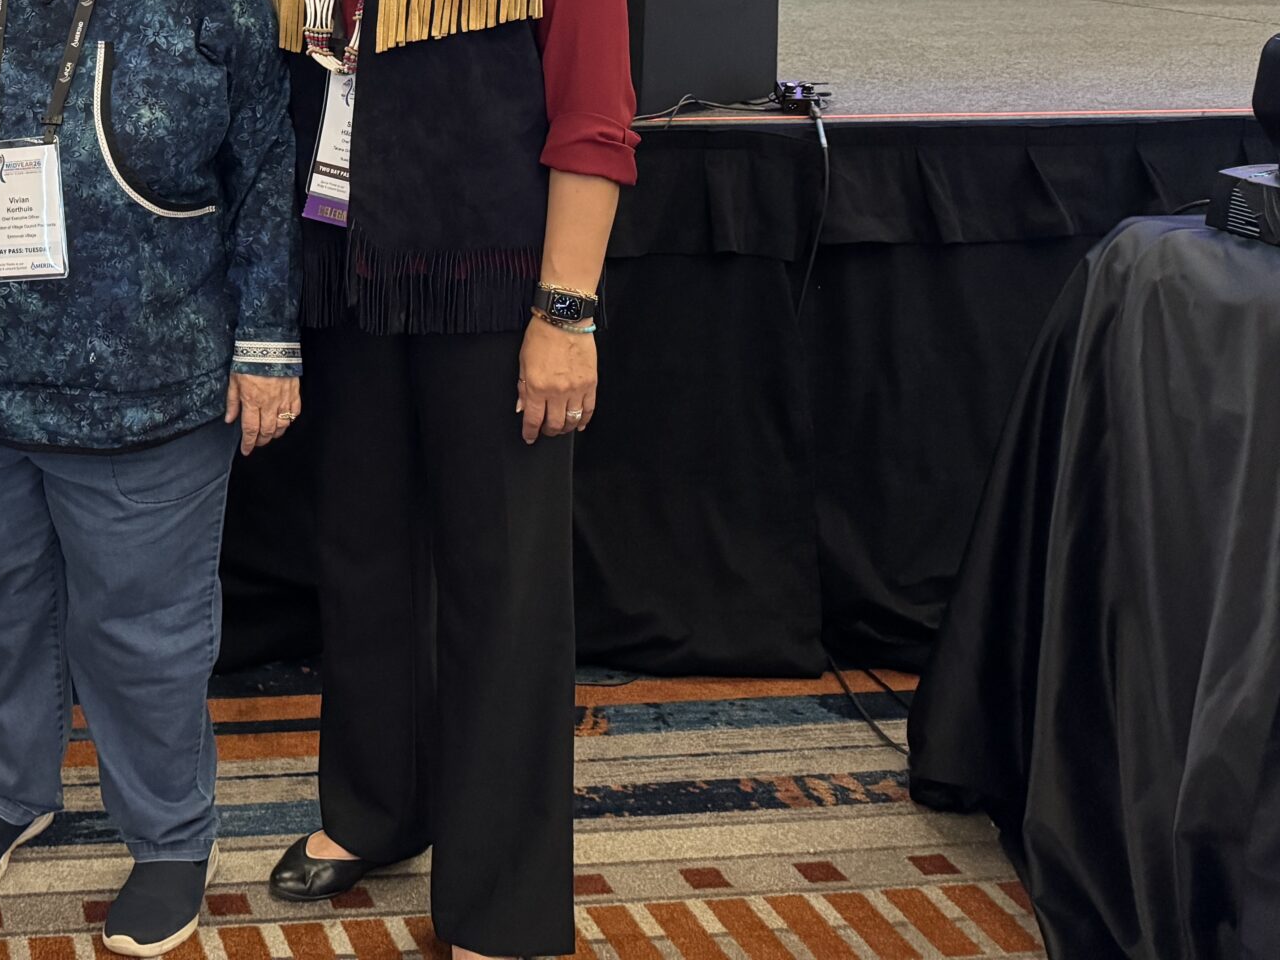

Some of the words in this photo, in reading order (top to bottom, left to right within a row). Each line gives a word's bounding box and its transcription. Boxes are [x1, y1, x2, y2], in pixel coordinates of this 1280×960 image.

[70, 21, 84, 48] AMERIND
[5, 160, 42, 169] MIDYEAR26
[8, 196, 30, 204] Vivian
[30, 262, 55, 271] AMERIN
